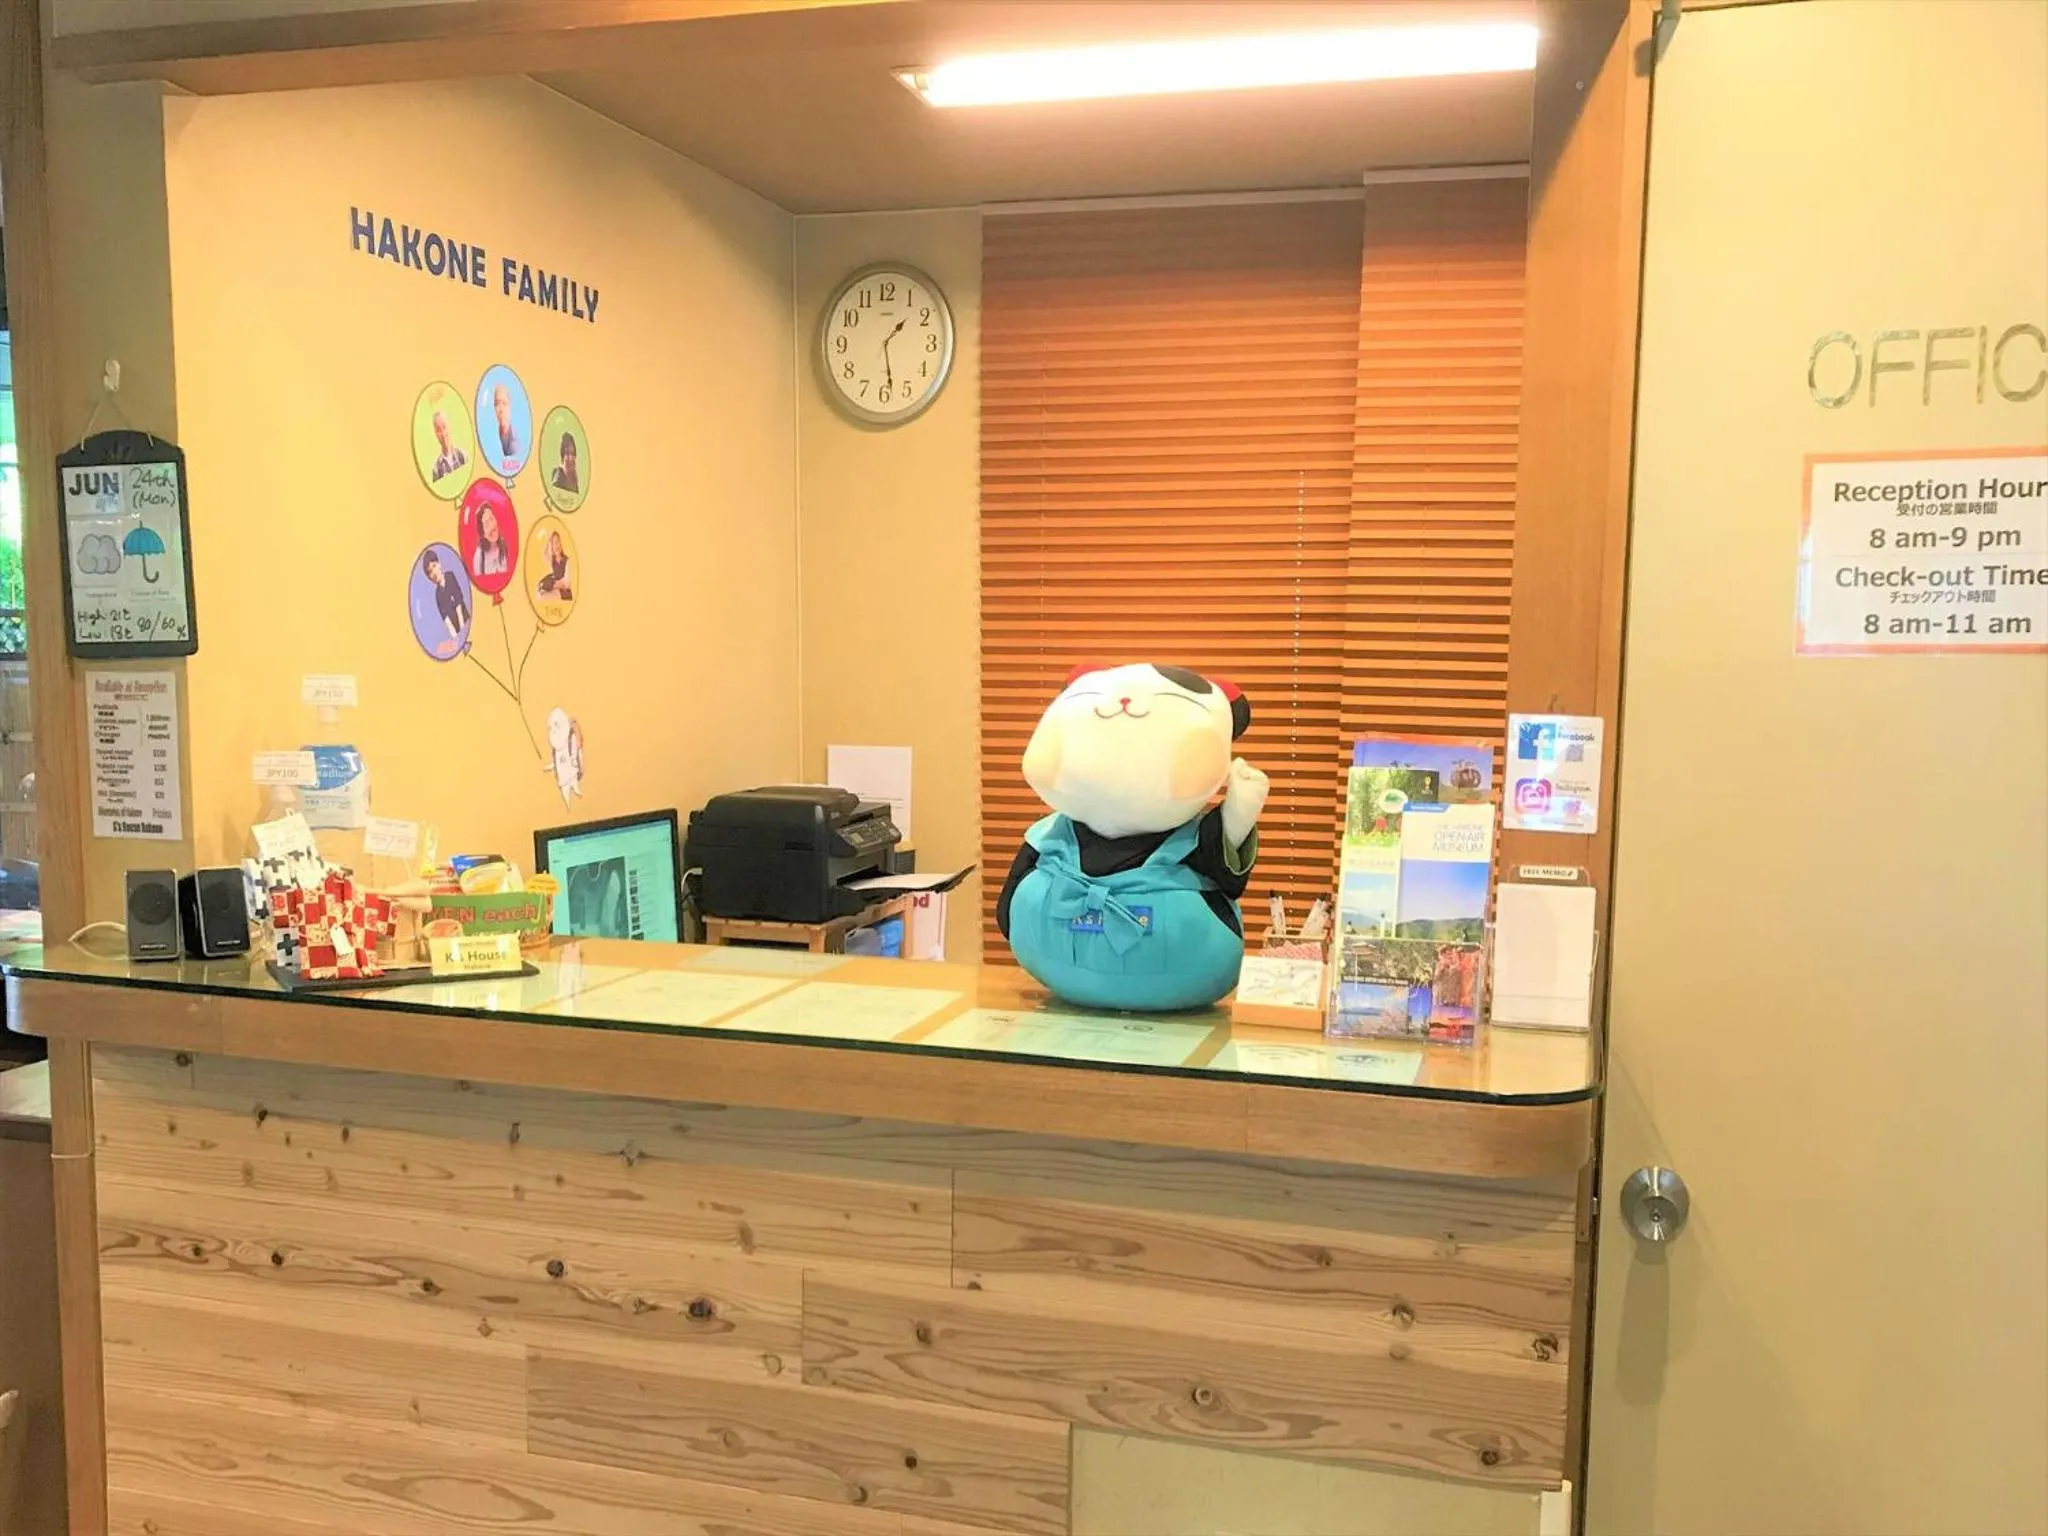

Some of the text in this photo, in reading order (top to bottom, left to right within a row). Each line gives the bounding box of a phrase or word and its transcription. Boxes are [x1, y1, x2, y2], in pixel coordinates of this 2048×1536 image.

[350, 206, 599, 323] HAKONE FAMILY
[858, 290, 872, 308] 11
[880, 282, 895, 301] 12
[906, 289, 913, 307] 1
[843, 308, 859, 328] 10
[919, 307, 930, 327] 2
[836, 334, 847, 354] 9
[925, 333, 937, 353] 3
[843, 361, 855, 379] 8
[917, 360, 927, 378] 4
[859, 379, 870, 398] 7
[878, 384, 891, 404] 6
[901, 381, 912, 398] 5
[69, 472, 120, 496] JUN
[1834, 477, 2048, 503] Reception Hour
[132, 489, 176, 509] (Mon)
[1896, 501, 1999, 517] 受付の営業時間
[1869, 526, 2022, 552] 8 am-9 pm
[1835, 564, 2048, 588] Check-out Time
[1889, 589, 1997, 604] チェックアウト時間
[1864, 613, 2032, 635] 8 am-11 am
